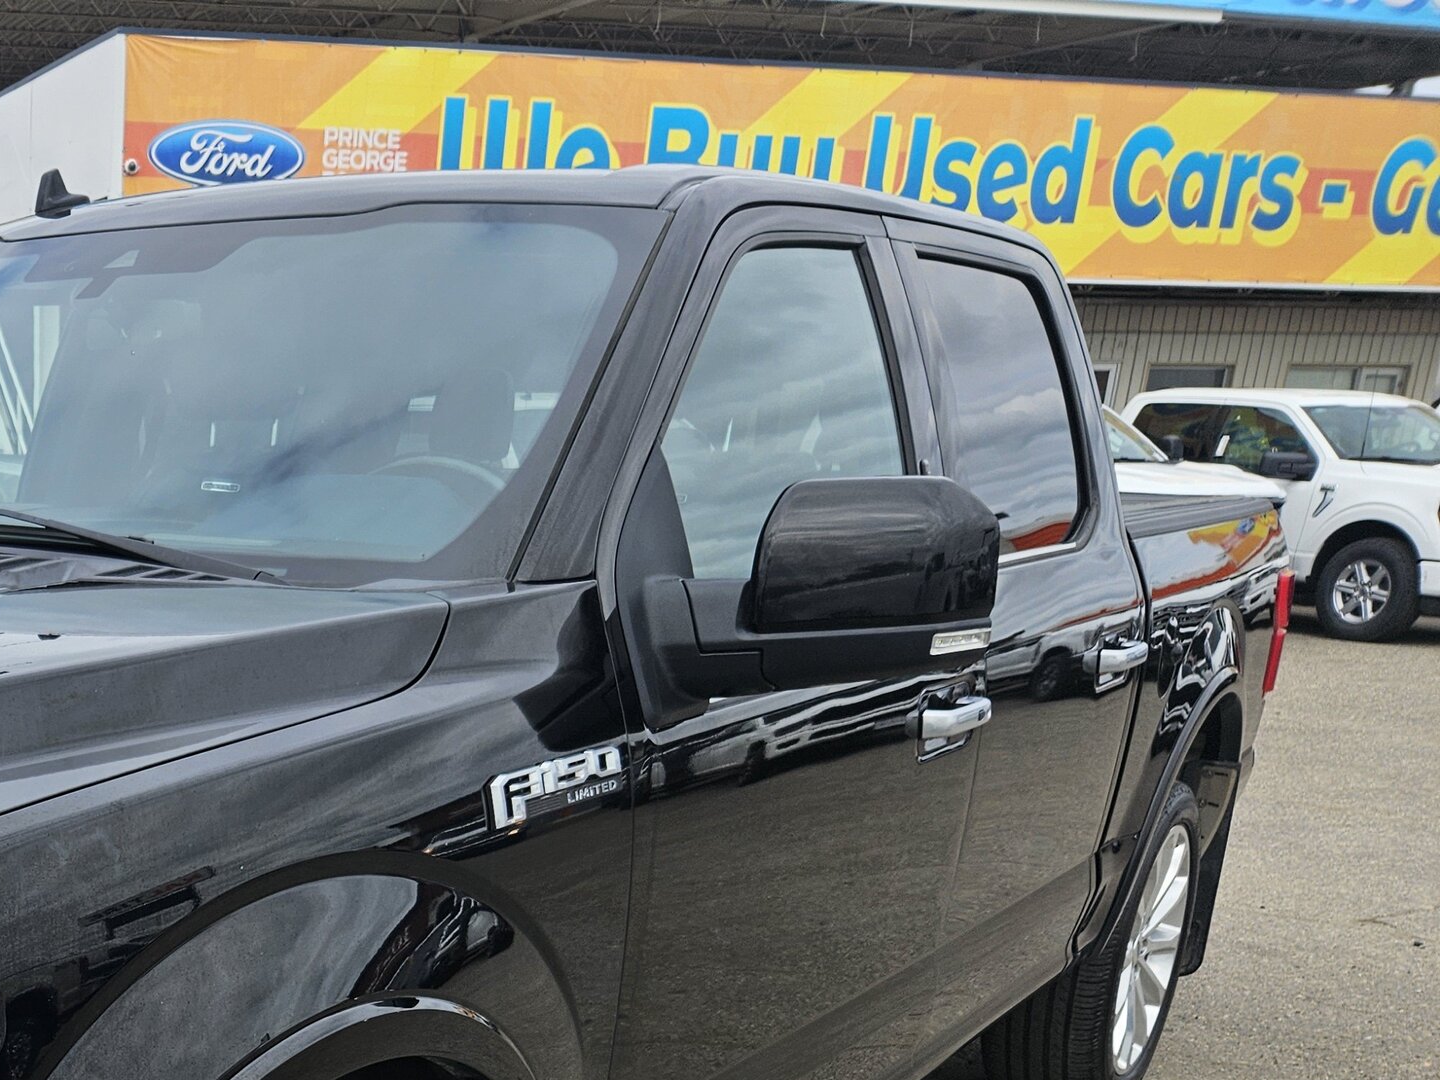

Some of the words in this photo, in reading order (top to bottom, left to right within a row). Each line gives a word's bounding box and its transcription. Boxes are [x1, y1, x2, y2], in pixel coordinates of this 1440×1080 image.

[323, 127, 401, 149] PRINCE
[180, 129, 276, 178] Ford
[322, 149, 407, 172] GEORGE
[865, 114, 1093, 224] Used
[1113, 124, 1301, 231] Cars
[1371, 138, 1440, 236] G
[566, 779, 618, 804] LIMITED
